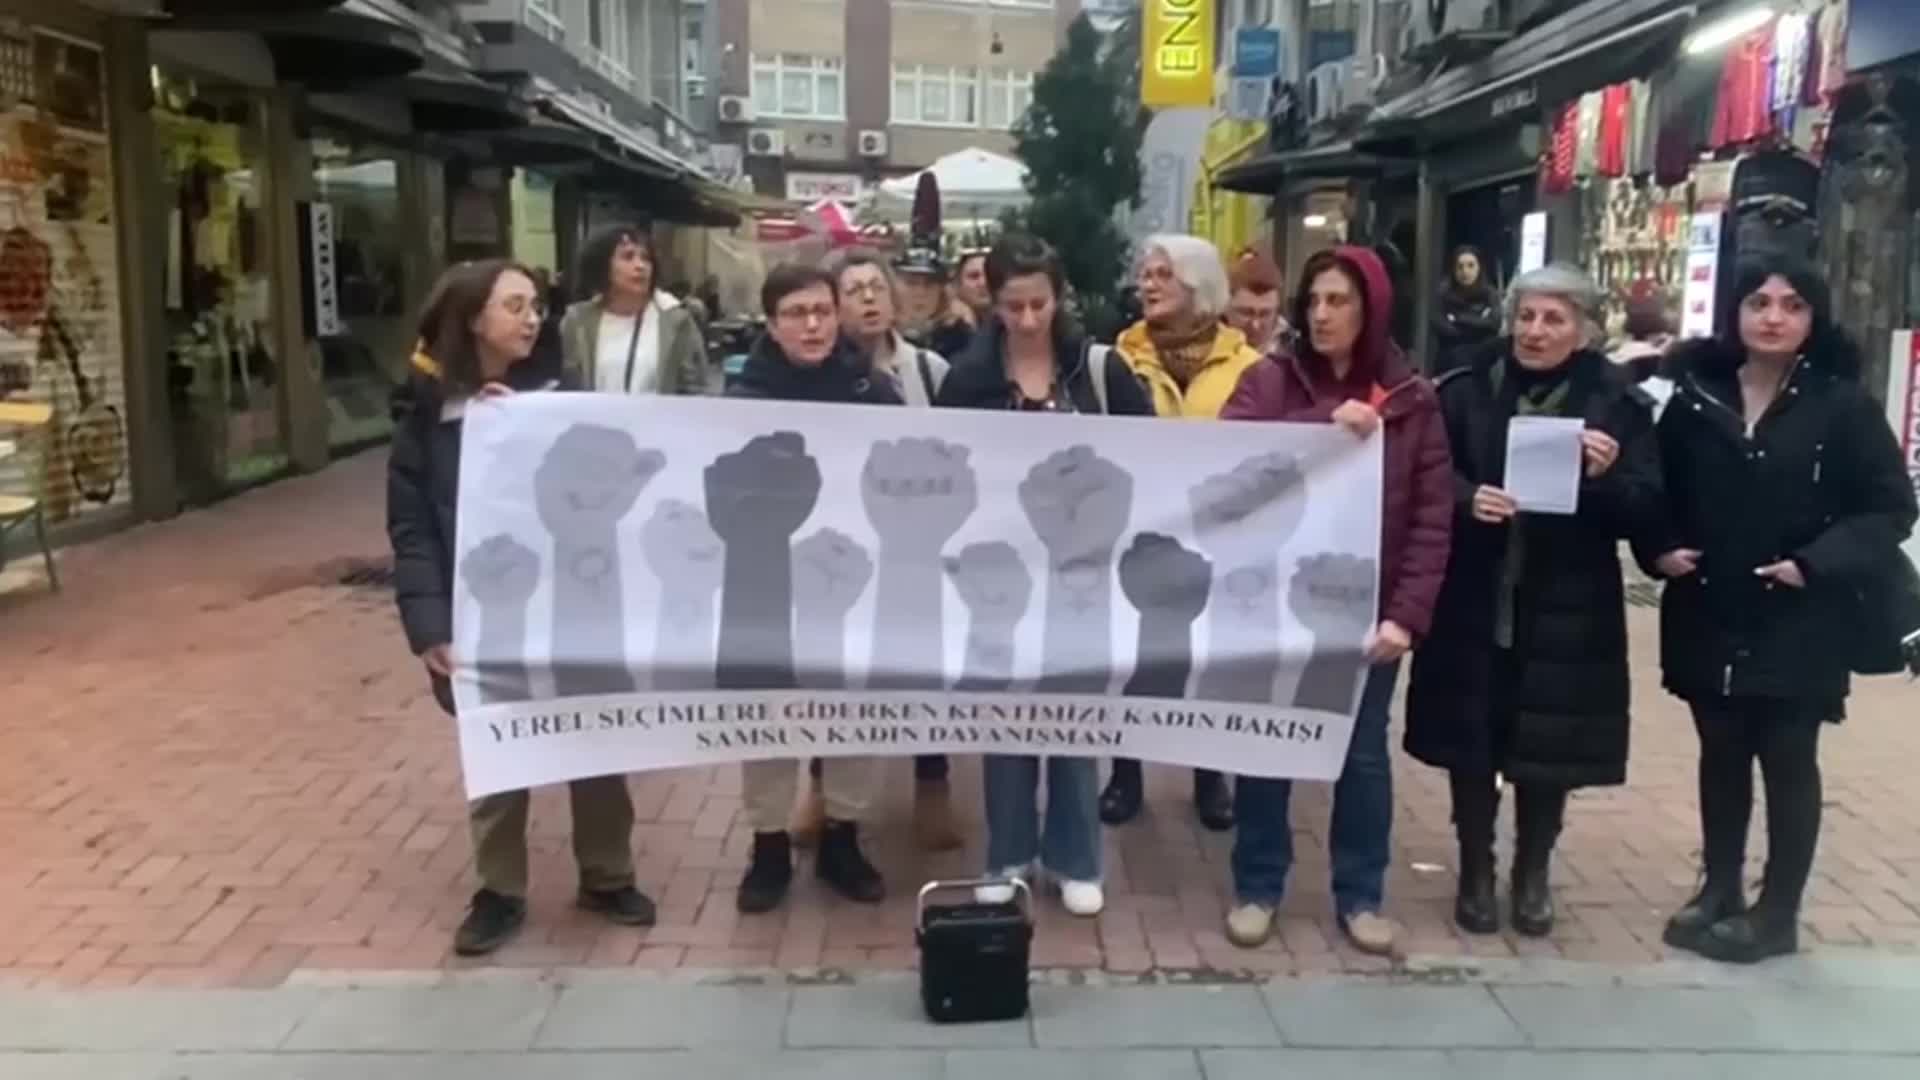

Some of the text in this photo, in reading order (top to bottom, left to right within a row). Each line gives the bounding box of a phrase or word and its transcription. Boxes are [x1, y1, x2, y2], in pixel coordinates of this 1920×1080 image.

[489, 711, 593, 743] YEREL
[597, 700, 772, 730] SEÇİMLERE
[782, 699, 939, 721] GİDERKEN
[1122, 708, 1216, 729] KADIN
[1224, 715, 1325, 743] BAKIŞI
[696, 726, 1123, 749] SAMSUN KADIN DAYANIŞMASI
